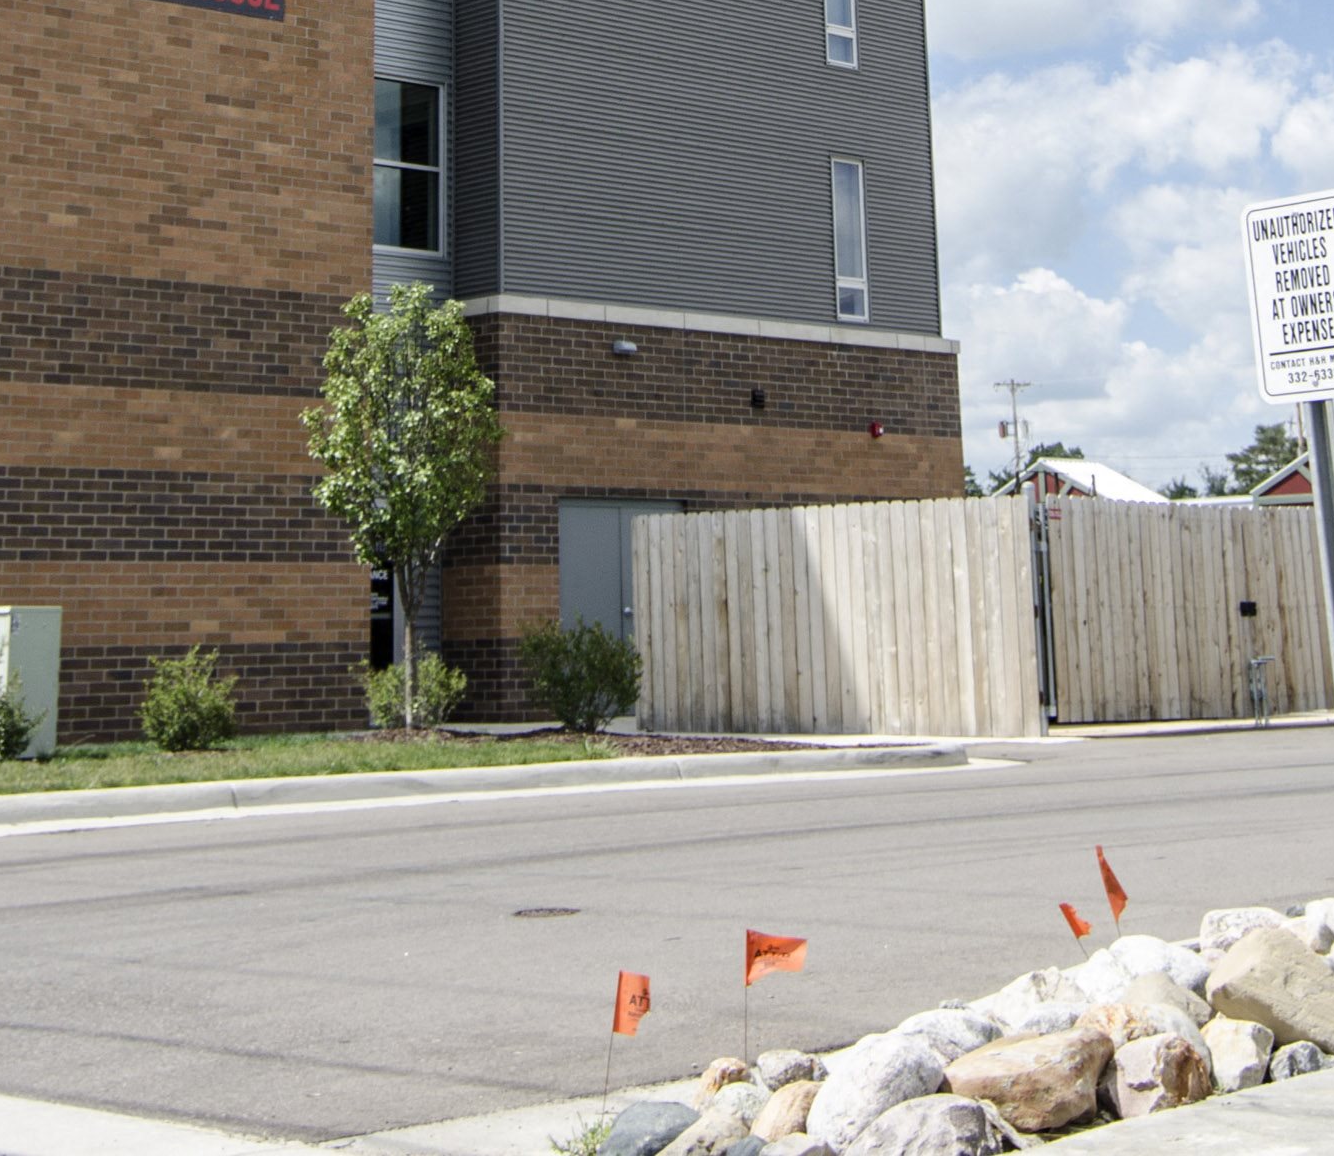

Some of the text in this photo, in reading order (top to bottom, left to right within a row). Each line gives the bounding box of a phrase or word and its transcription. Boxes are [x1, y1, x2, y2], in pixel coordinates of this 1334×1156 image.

[1271, 236, 1328, 266] VEHICLES
[1275, 264, 1331, 293] REMOVED
[1272, 297, 1285, 320] AT
[1270, 357, 1306, 371] CONTACT
[1308, 355, 1327, 366] H&H
